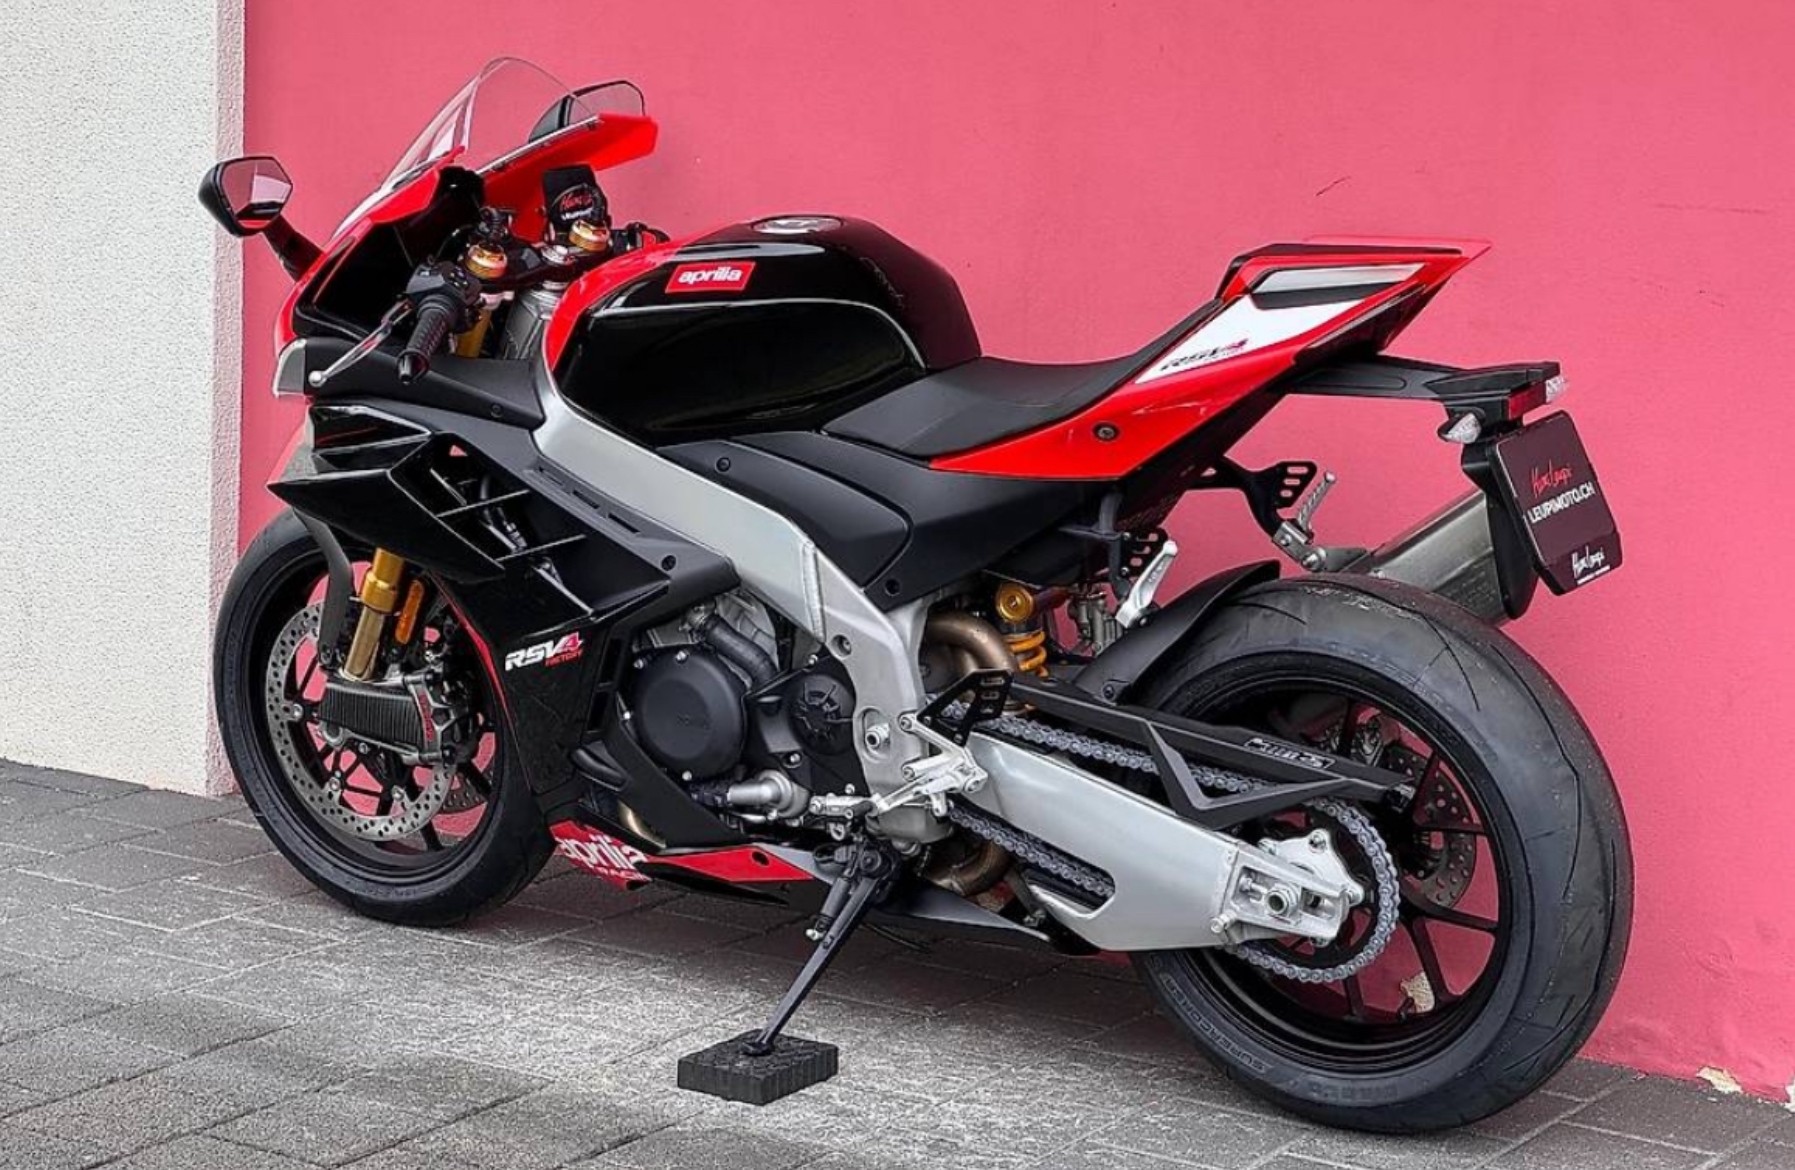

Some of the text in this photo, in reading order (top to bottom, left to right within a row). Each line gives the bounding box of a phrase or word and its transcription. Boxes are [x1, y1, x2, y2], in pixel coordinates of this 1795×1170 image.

[678, 266, 743, 285] aprilia
[505, 632, 583, 671] RSV4
[555, 834, 648, 870] aprilia
